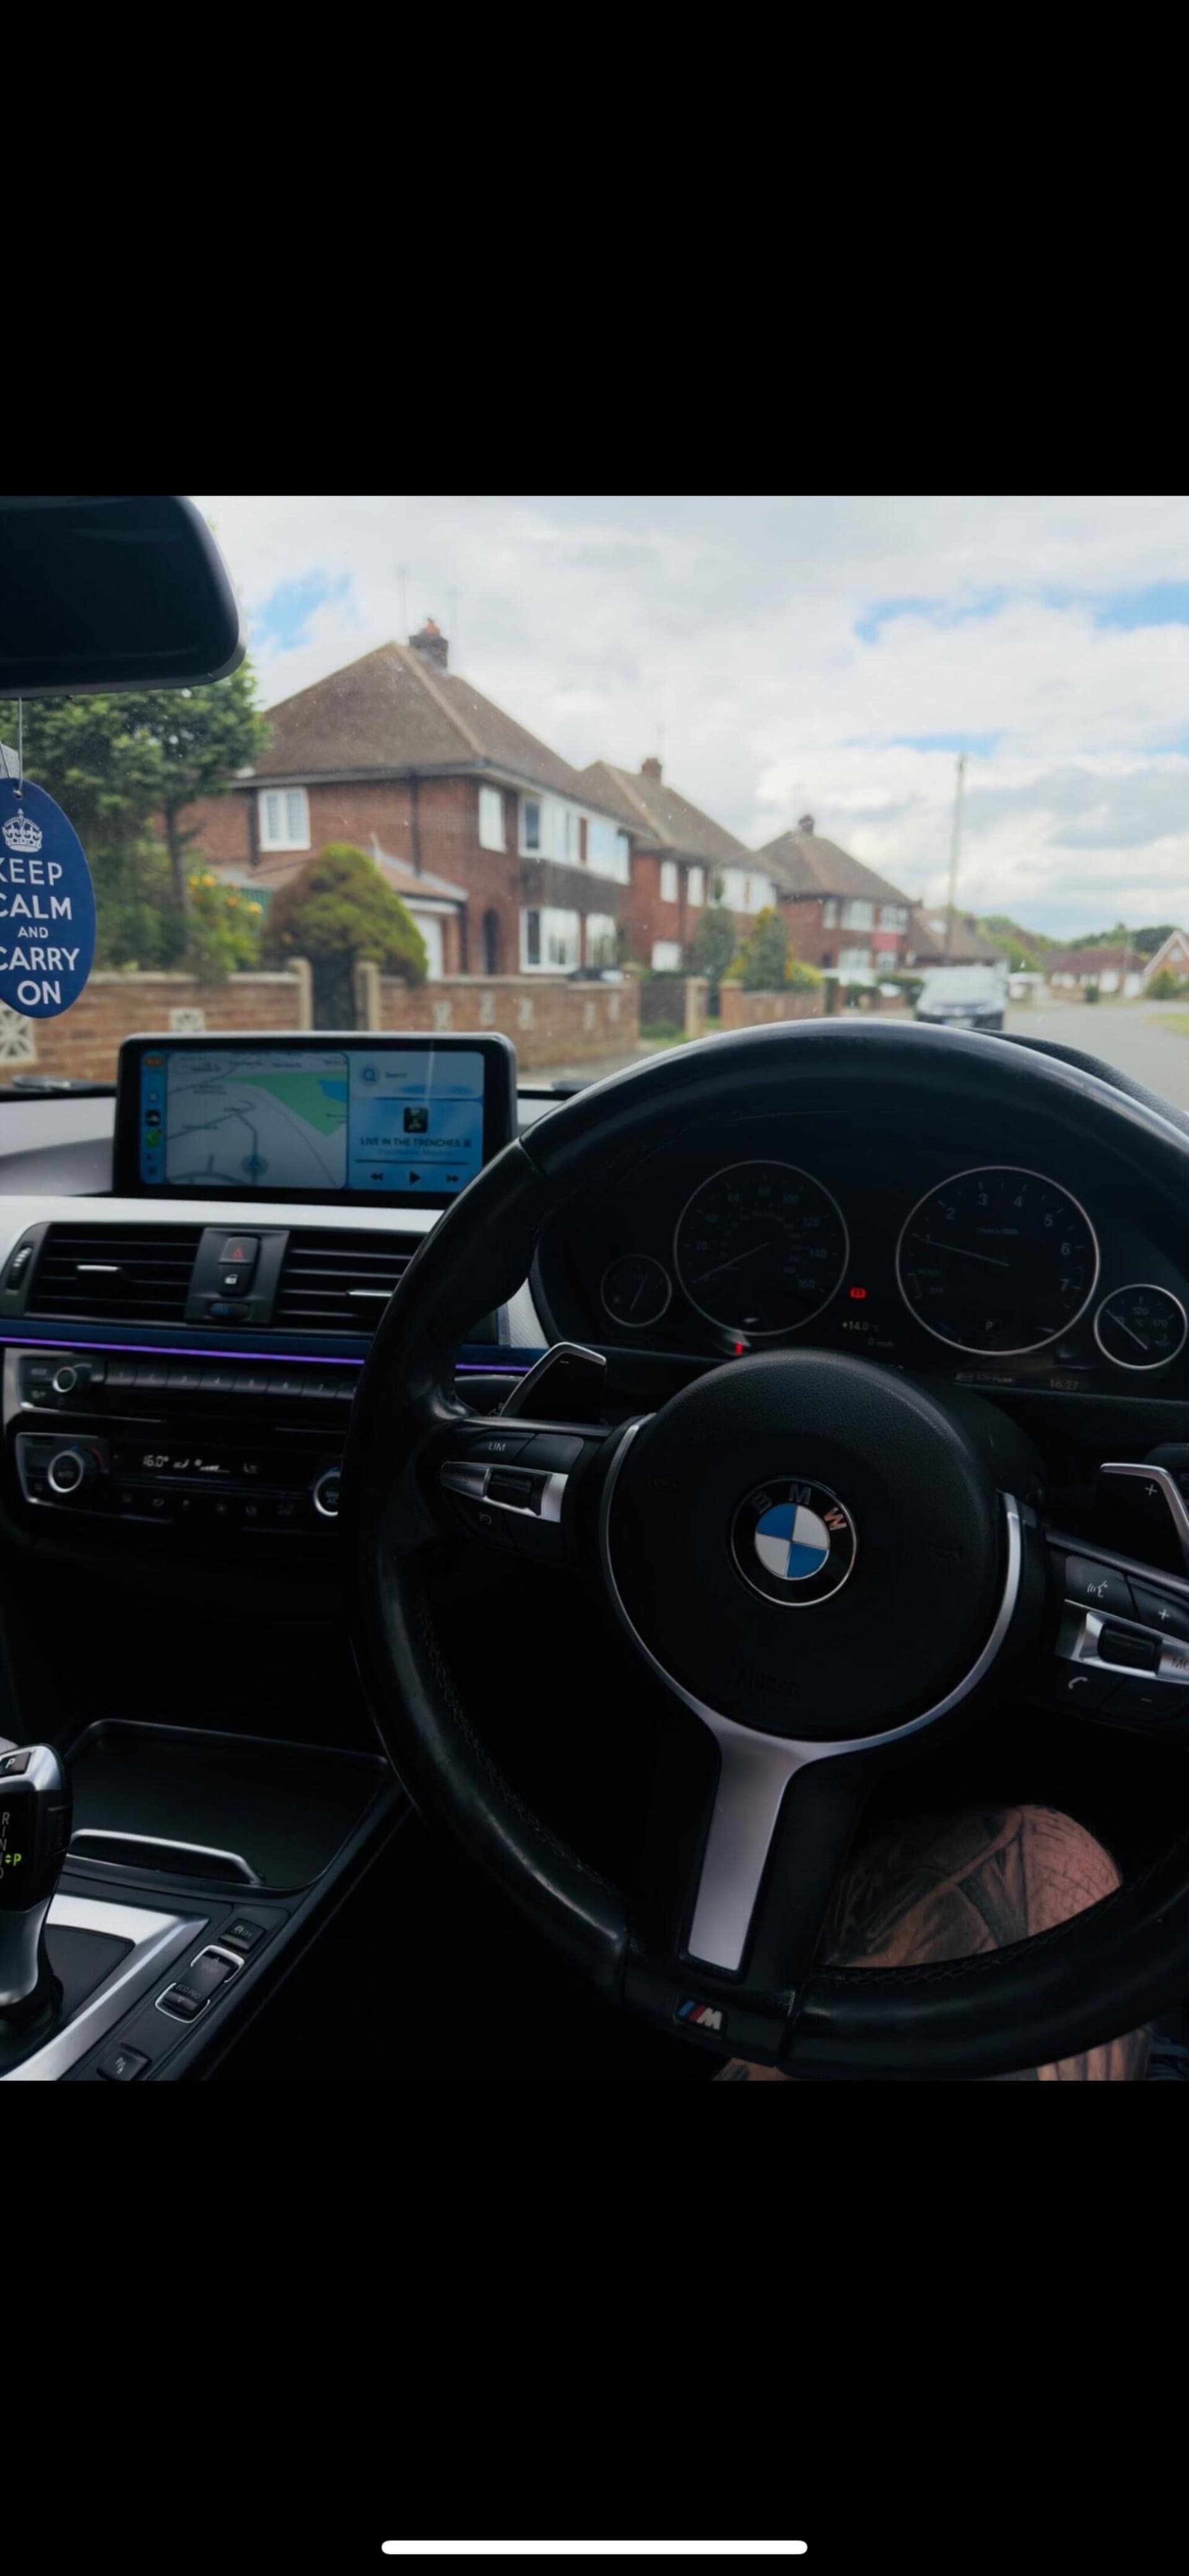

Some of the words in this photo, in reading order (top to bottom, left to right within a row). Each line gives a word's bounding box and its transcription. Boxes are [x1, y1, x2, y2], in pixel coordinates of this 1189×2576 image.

[0, 857, 63, 886] EEP
[17, 926, 48, 939] AND
[17, 980, 61, 1006] ON
[360, 1137, 379, 1146] LIVE
[381, 1138, 391, 1146] IN
[394, 1138, 411, 1147] THE
[977, 1194, 988, 1206] 3
[1013, 1195, 1023, 1208] 4
[946, 1207, 956, 1220] 2
[1043, 1213, 1054, 1227] 5
[1060, 1242, 1071, 1255] 6
[1060, 1278, 1071, 1292] 7
[984, 1320, 995, 1332] P
[488, 1442, 506, 1452] LIM
[750, 1482, 847, 1531] BMW
[5, 1758, 15, 1769] P
[1, 1811, 11, 1826] R
[12, 1853, 22, 1867] P
